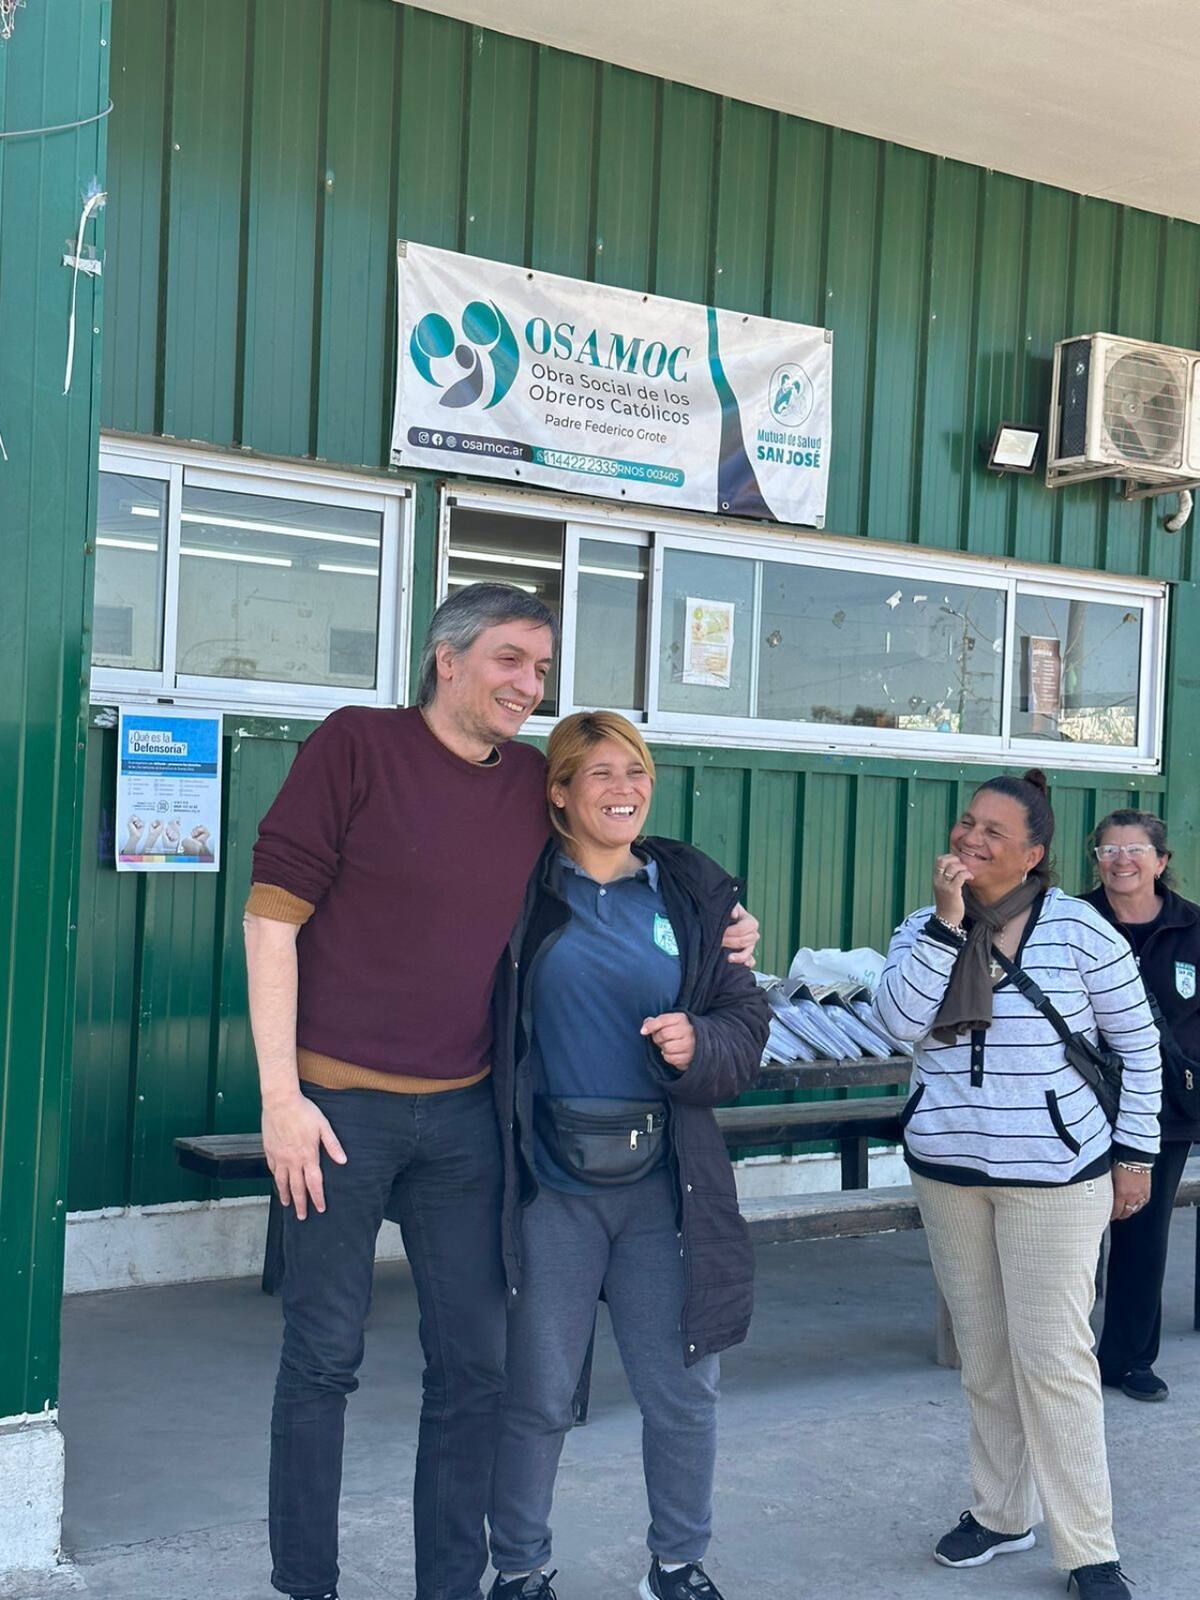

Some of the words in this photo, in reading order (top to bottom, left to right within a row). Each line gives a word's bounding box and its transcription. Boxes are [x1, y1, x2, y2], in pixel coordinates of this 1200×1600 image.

[525, 317, 691, 383] OSAMOC
[531, 363, 574, 386] Obra
[580, 374, 631, 397] Social
[637, 386, 659, 401] de
[664, 389, 690, 406] los
[529, 384, 605, 411] Obreros
[611, 399, 690, 425] Católicos
[545, 413, 582, 430] Padre
[585, 420, 634, 438] Federico
[636, 428, 667, 444] Grote
[757, 429, 786, 445] Mutual
[787, 433, 796, 446] de
[797, 435, 822, 449] Salud
[461, 439, 524, 456] osamoc.ar
[757, 445, 784, 463] SAN
[786, 450, 820, 468] JOSÉ
[617, 464, 645, 478] RNOS
[646, 466, 679, 483] 003405
[151, 734, 161, 743] es
[163, 733, 171, 743] la
